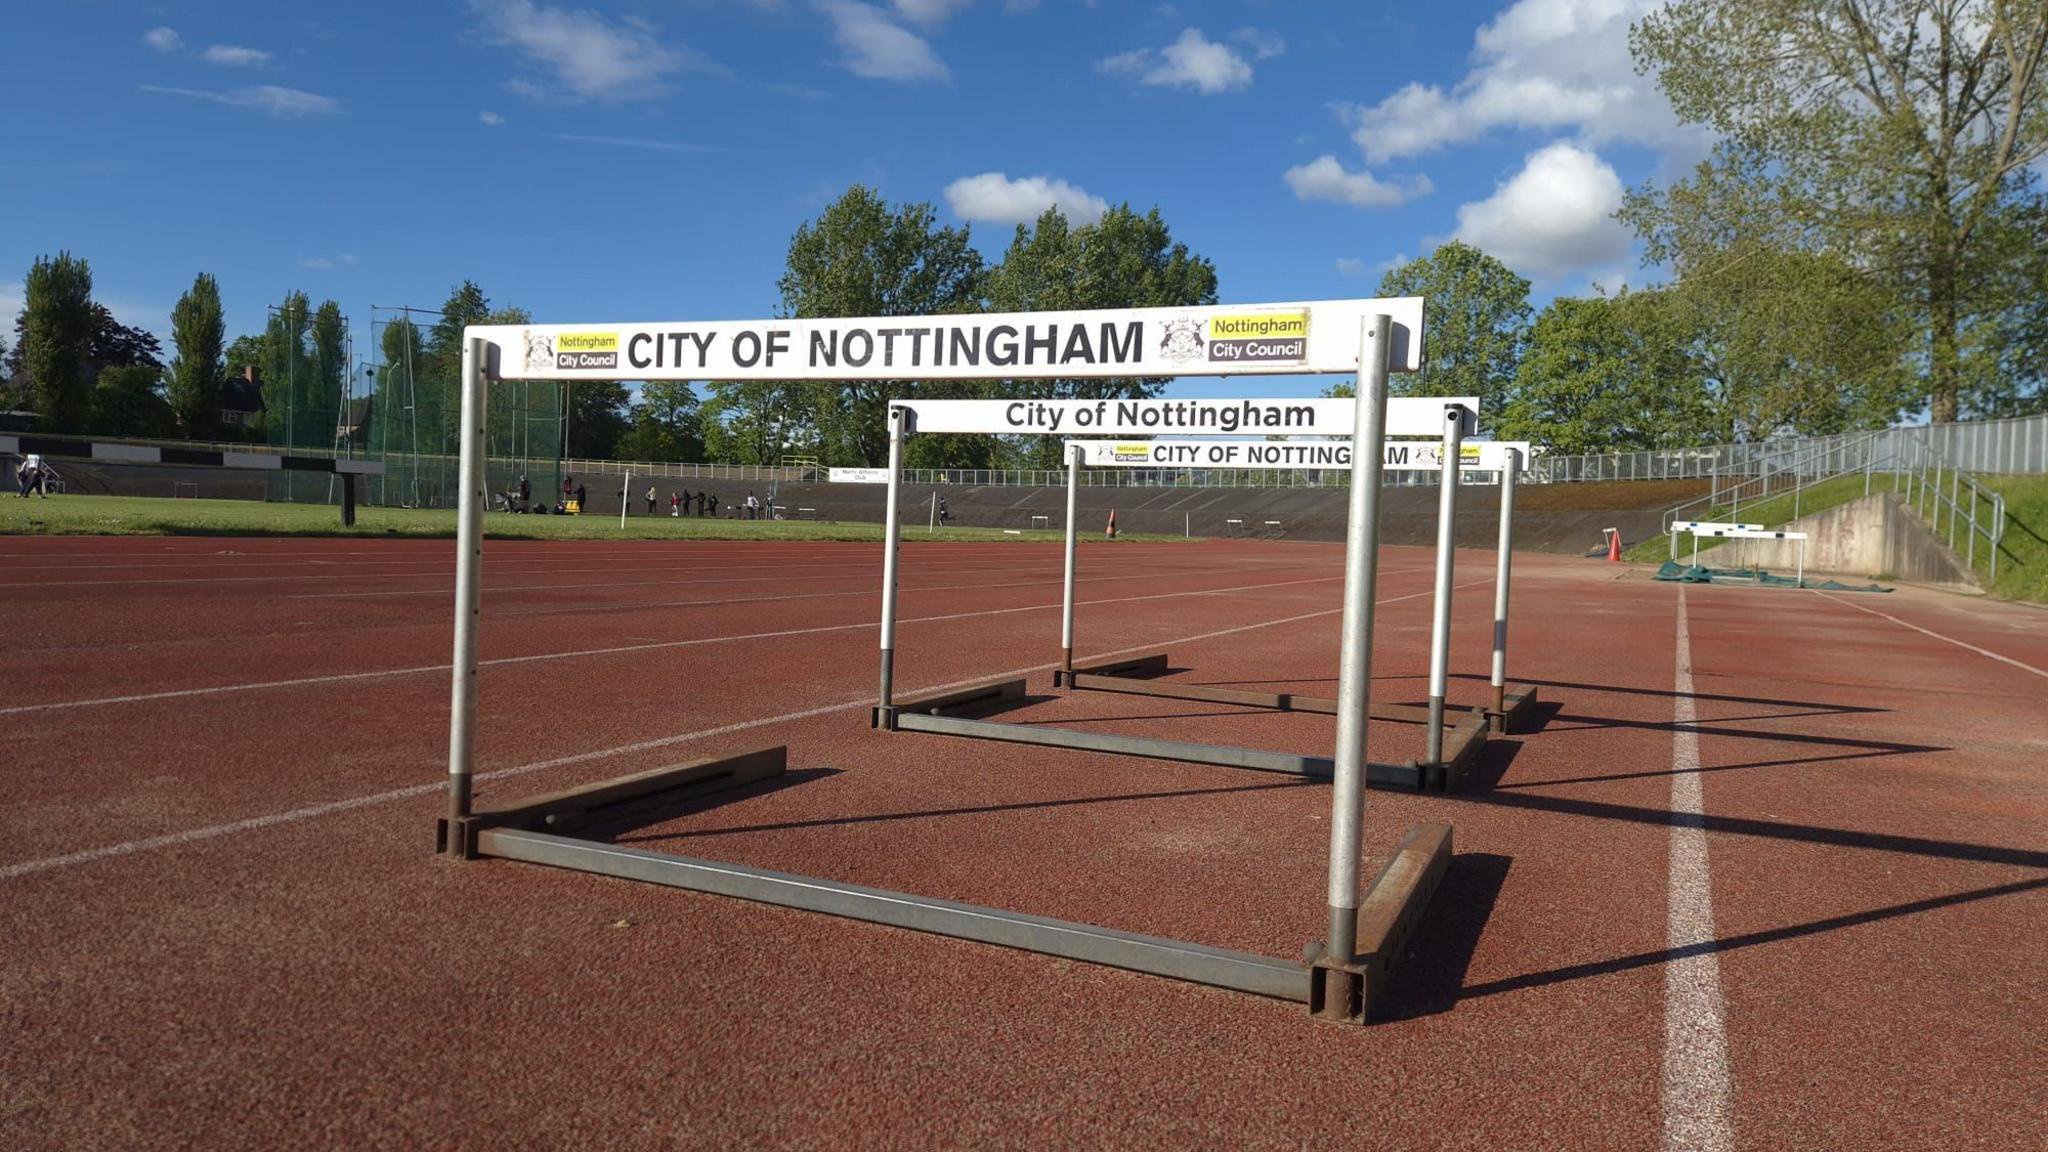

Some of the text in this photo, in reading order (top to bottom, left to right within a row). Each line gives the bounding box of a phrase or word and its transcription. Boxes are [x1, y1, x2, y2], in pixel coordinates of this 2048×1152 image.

[1215, 318, 1303, 335] Nottingham
[560, 335, 615, 349] Nottingham
[628, 321, 1143, 369] CITY OF NOTTINGHAM
[1213, 341, 1302, 360] City Council
[559, 353, 615, 368] City Council
[1006, 401, 1316, 432] City of Nottingham
[1153, 445, 1408, 465] CITY OF NOTTINGM
